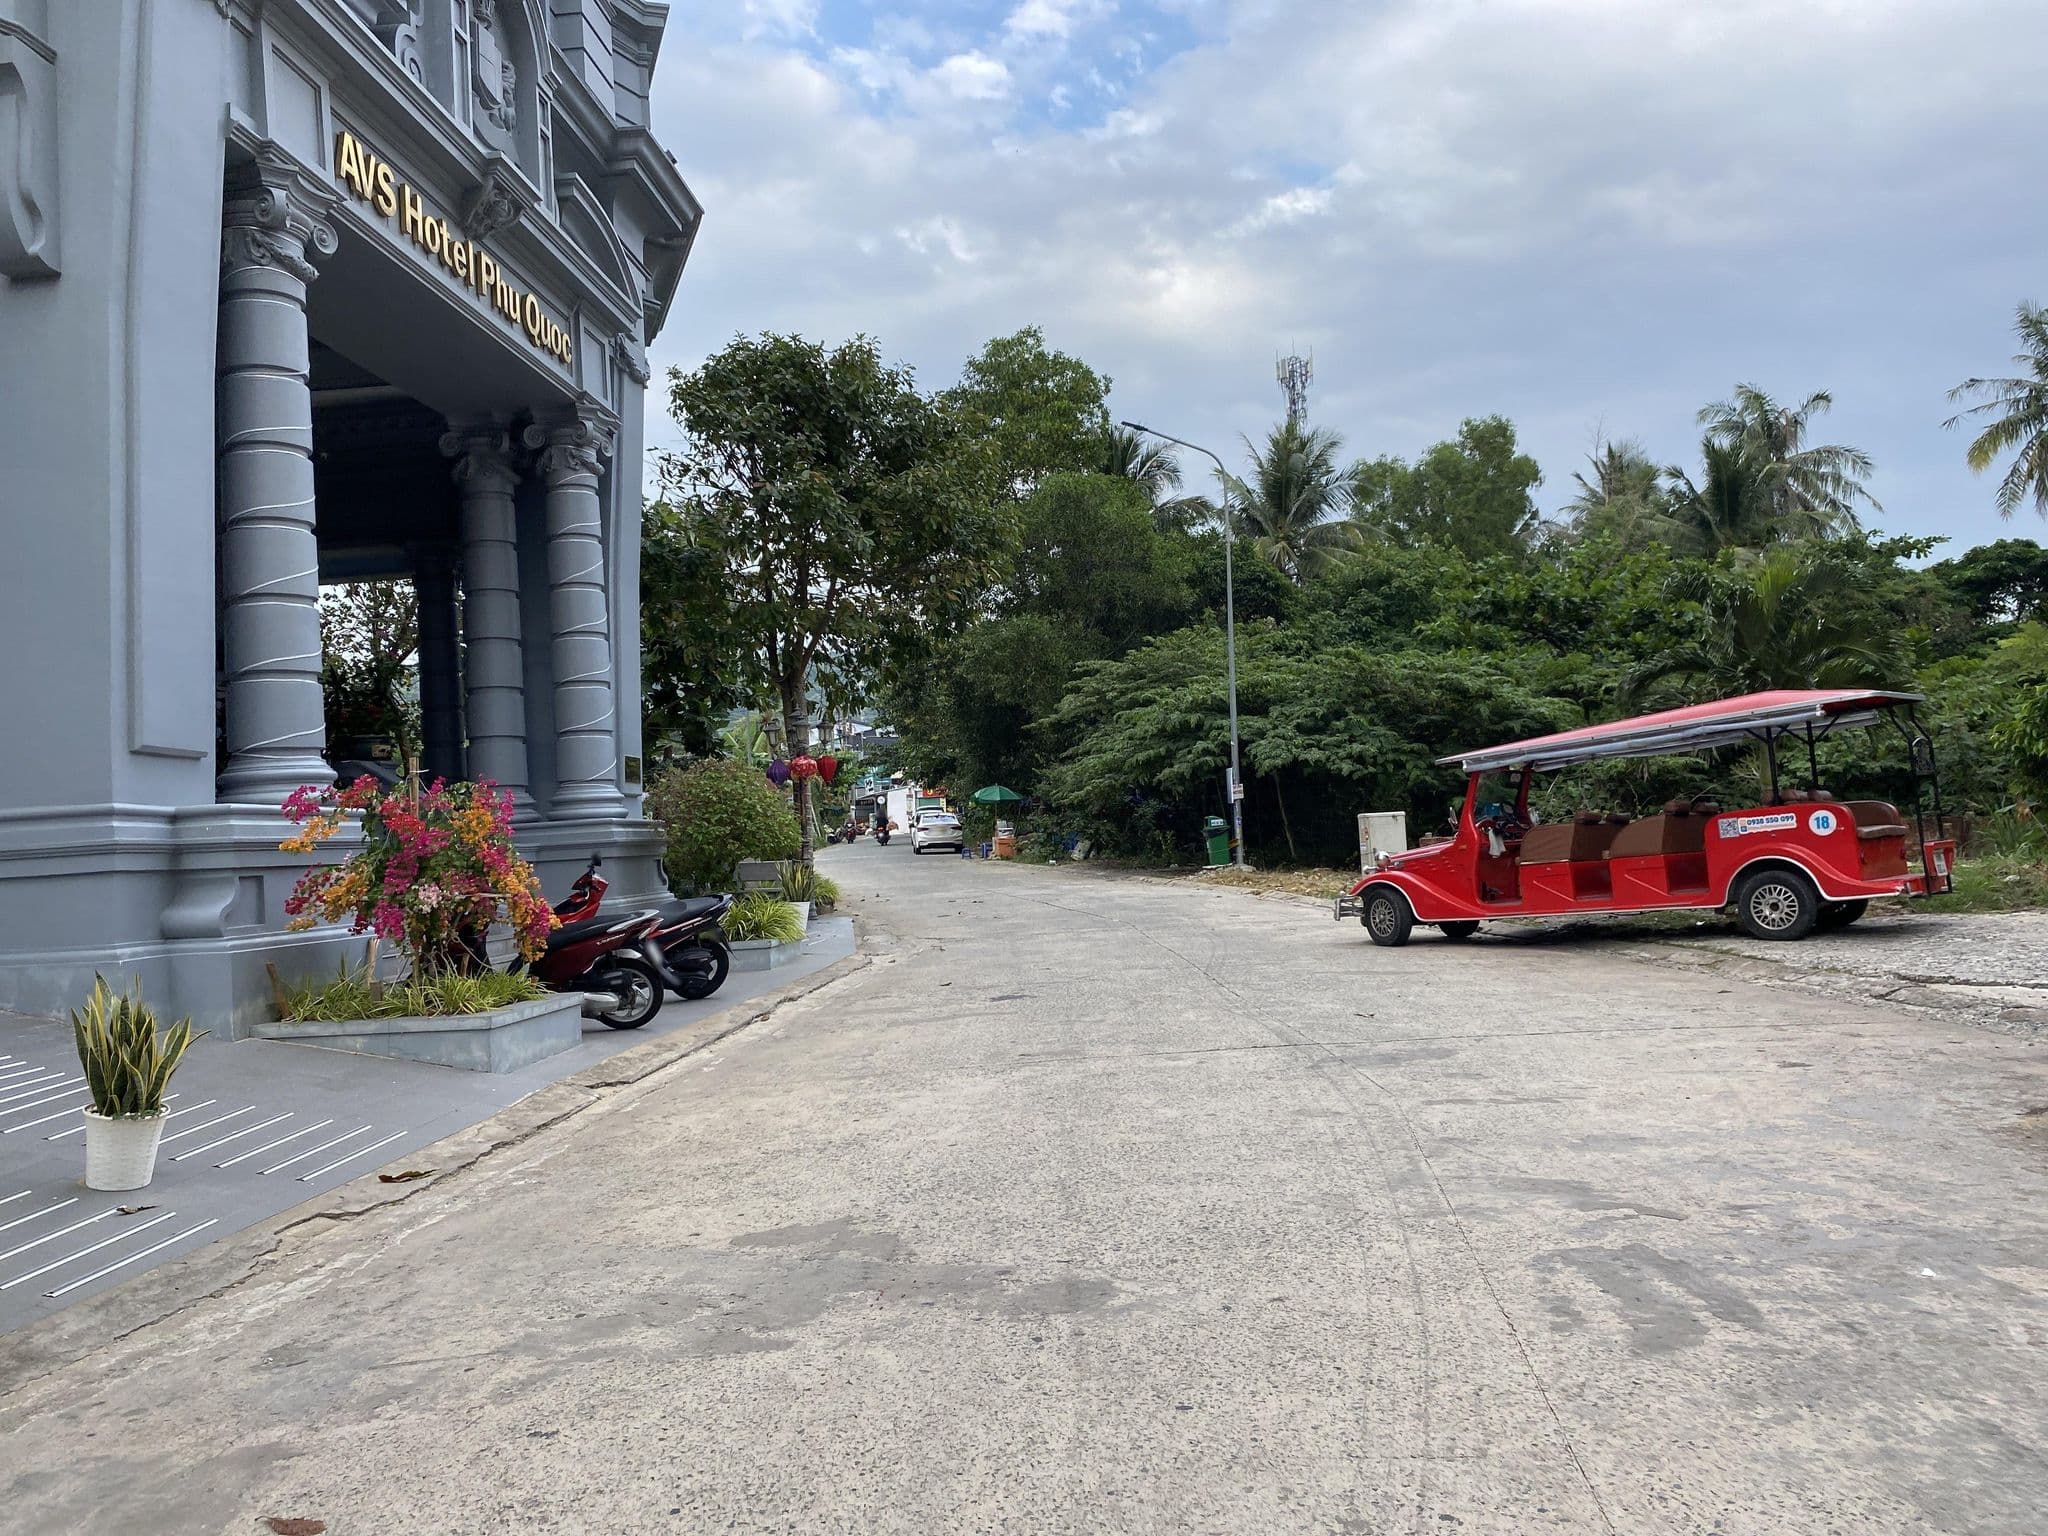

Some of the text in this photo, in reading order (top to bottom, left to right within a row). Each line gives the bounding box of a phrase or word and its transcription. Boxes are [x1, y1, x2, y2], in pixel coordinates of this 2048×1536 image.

[337, 131, 572, 364] AVS Hotel Phu Quoc
[1814, 816, 1830, 829] 18
